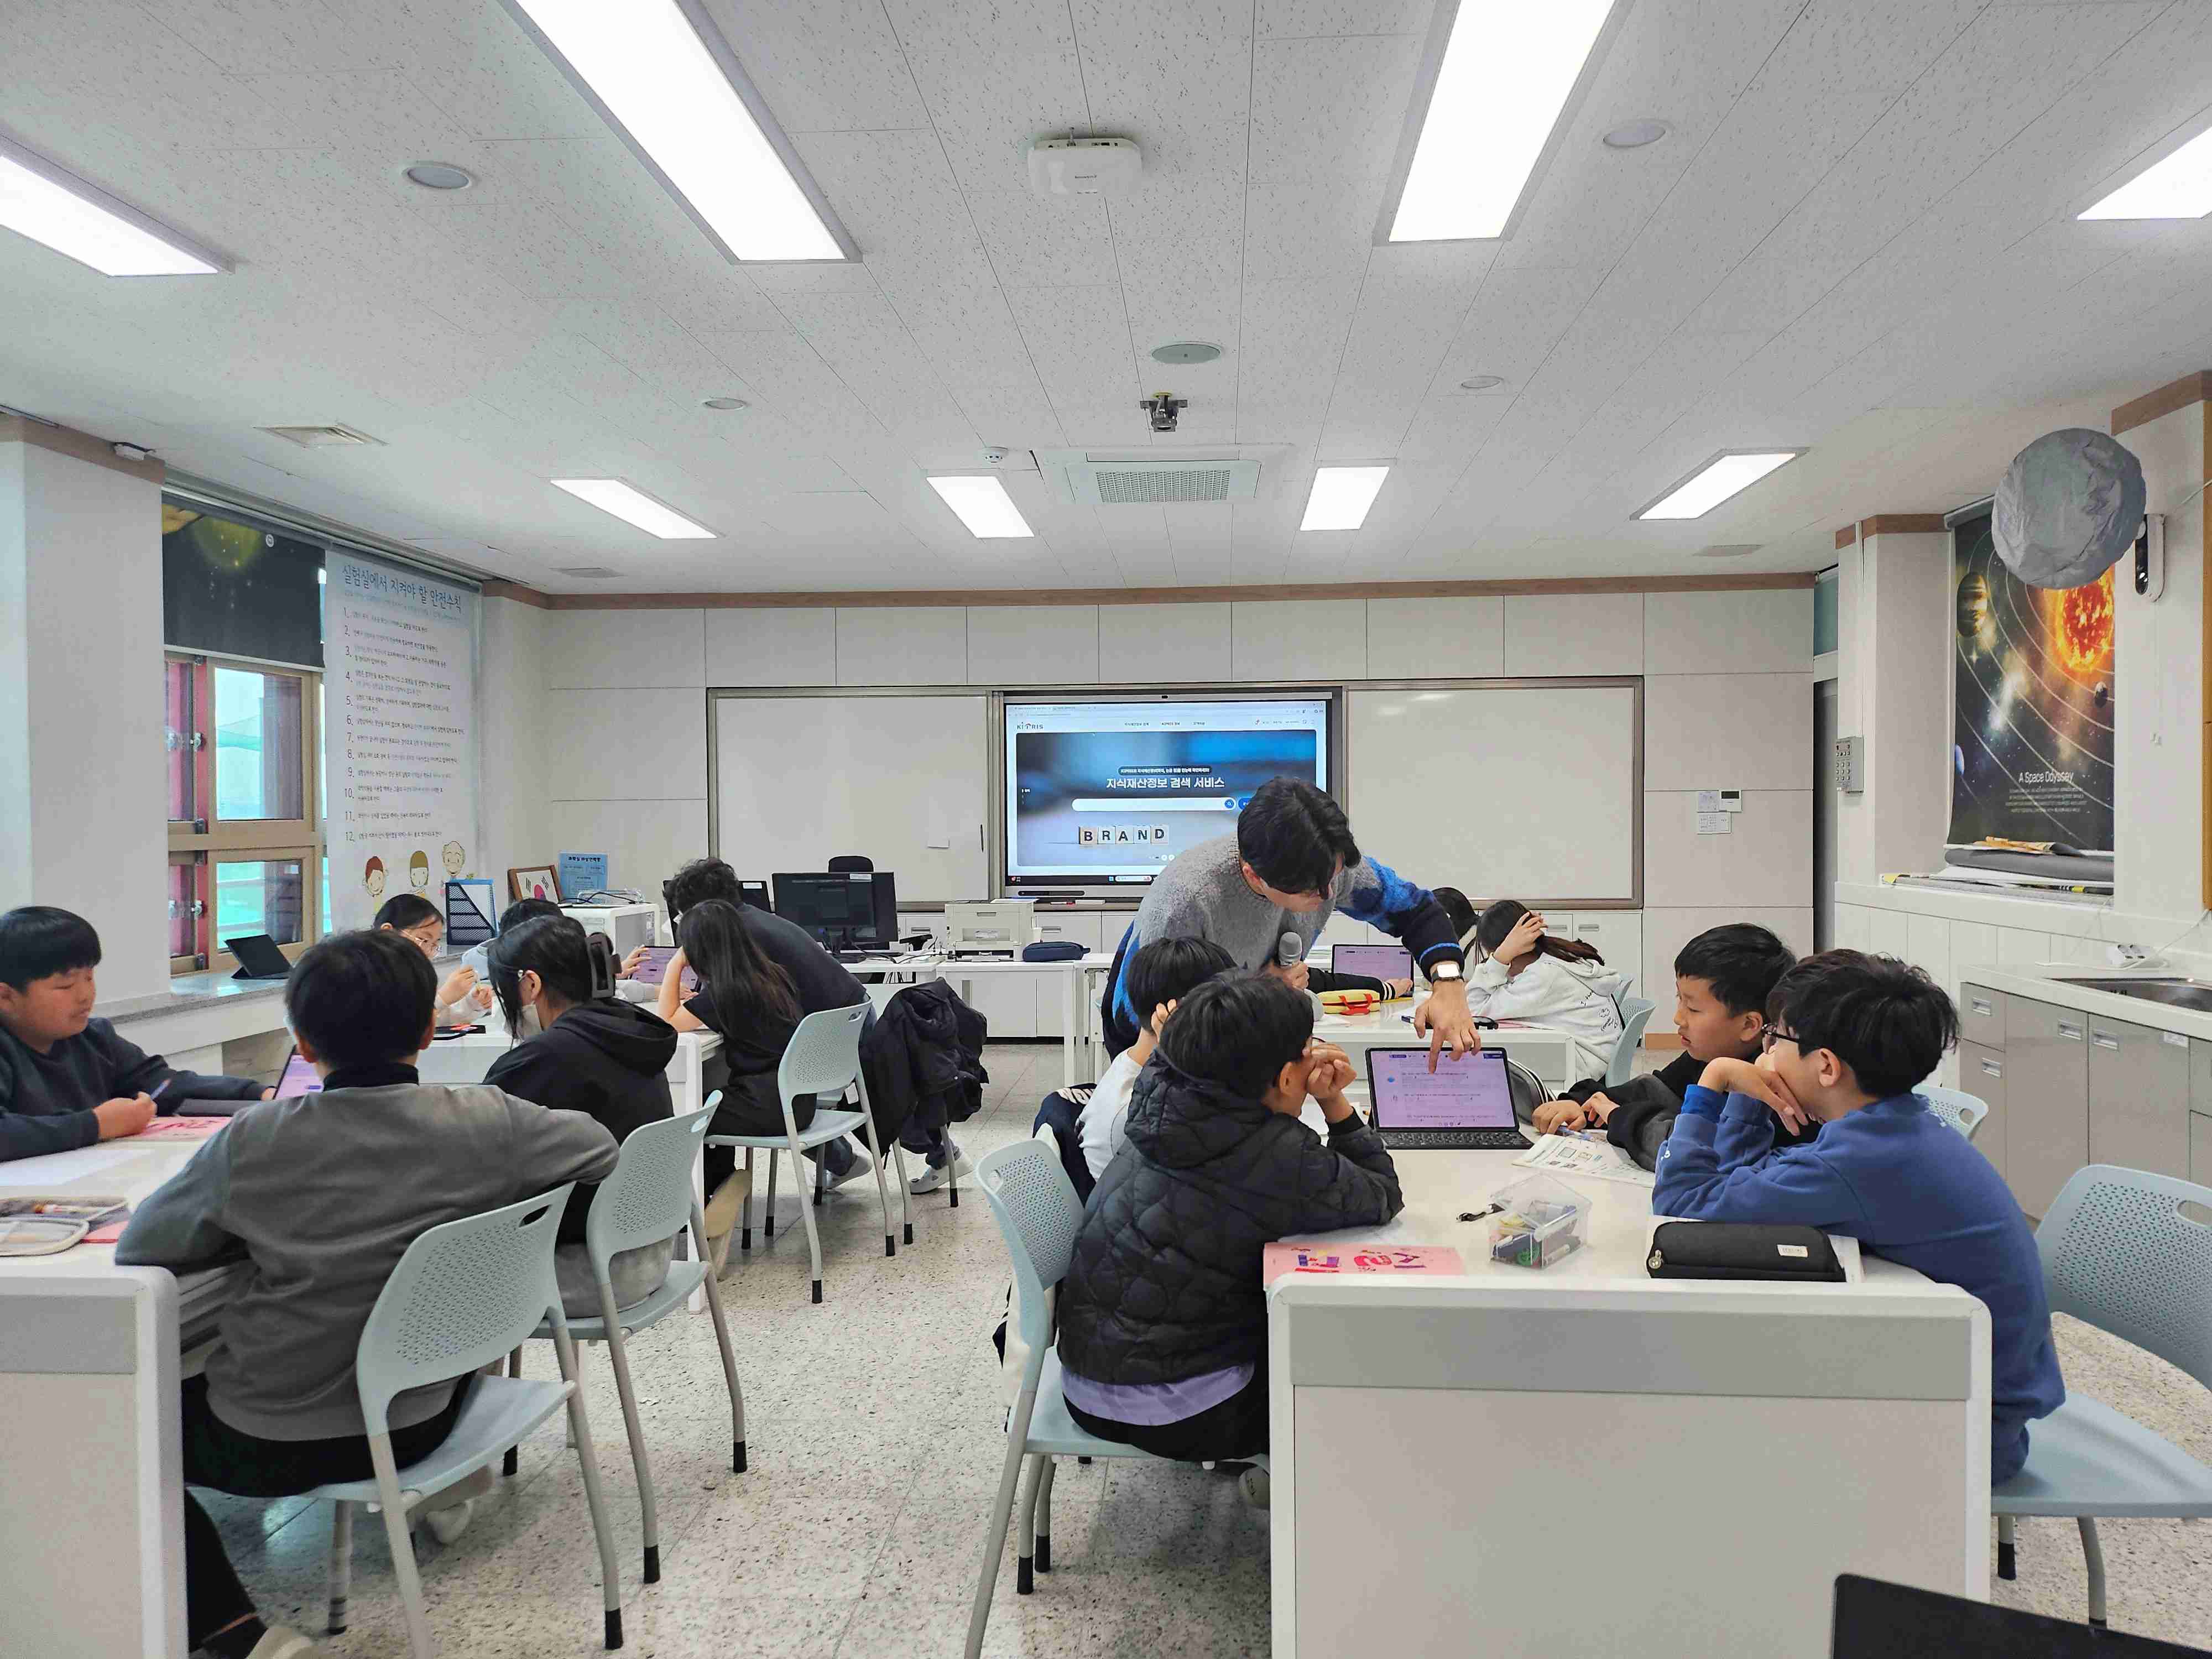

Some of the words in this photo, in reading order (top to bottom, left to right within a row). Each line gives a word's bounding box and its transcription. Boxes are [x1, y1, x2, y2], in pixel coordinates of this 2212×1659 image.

[342, 565, 388, 592] 실험실에서
[390, 580, 416, 600] 지켜야
[419, 586, 427, 604] 할
[430, 589, 462, 613] 안전수칙
[1107, 777, 1168, 789] 지식재산정보
[1170, 777, 1191, 789] 검색
[1193, 777, 1225, 789] 서비스
[2019, 773, 2024, 783] A
[2025, 771, 2044, 784] Space
[2045, 771, 2074, 784] Odyssey
[1084, 828, 1165, 841] BRAND
